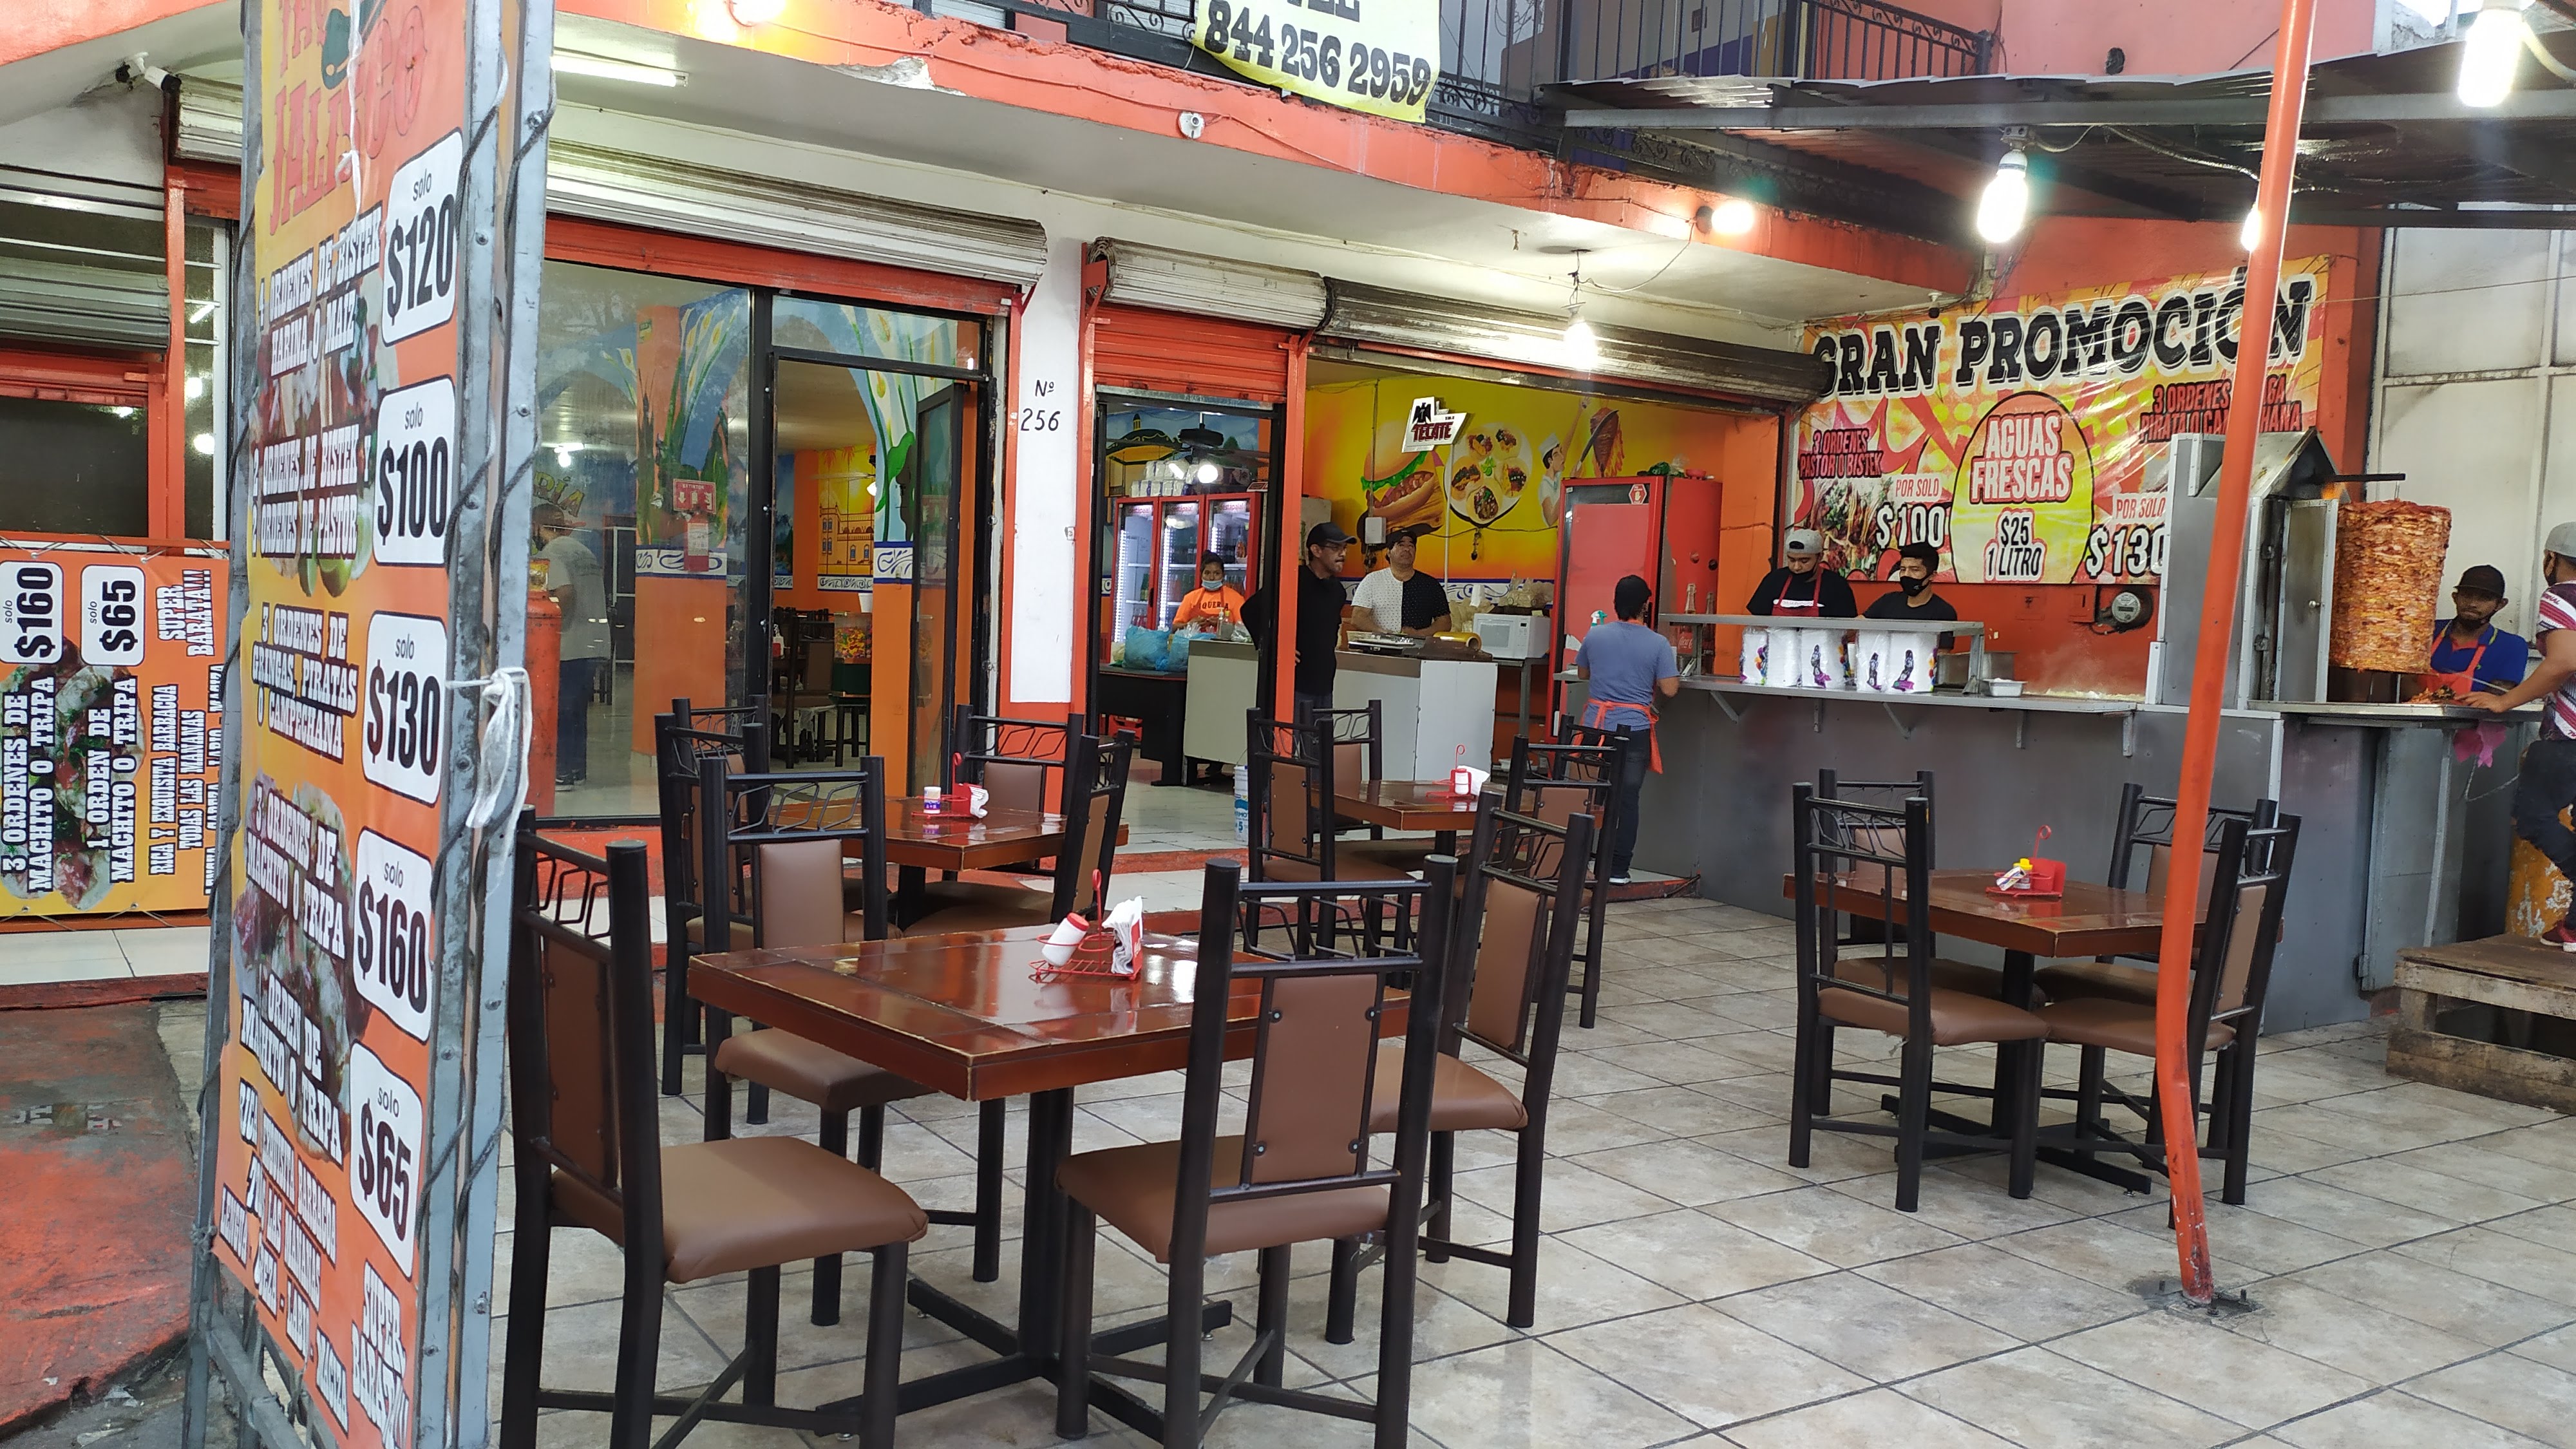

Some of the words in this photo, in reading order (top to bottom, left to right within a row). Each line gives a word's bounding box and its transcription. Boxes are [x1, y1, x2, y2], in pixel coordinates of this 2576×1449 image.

[1204, 0, 1274, 68] 844
[1281, 24, 1341, 88] 256
[1348, 42, 1431, 106] 2959
[413, 171, 432, 202] solo
[258, 279, 265, 328] 4
[270, 252, 314, 323] ORDENES
[316, 238, 334, 298] DE
[387, 194, 457, 326] $120
[271, 316, 308, 377] HARINA
[312, 307, 321, 361] O
[324, 282, 355, 355] MAÍZ
[405, 402, 423, 430] solo
[1020, 408, 1061, 431] 256
[2141, 413, 2187, 442] PIRATA
[2190, 411, 2201, 433] O
[2203, 402, 2301, 435] CAHANA
[2152, 385, 2164, 413] 3
[2166, 380, 2231, 413] ORDENES
[252, 449, 258, 497] 2
[263, 439, 301, 495] ORDENES
[303, 435, 317, 490] DE
[321, 424, 359, 488] BISTEK
[364, 435, 371, 482] Y
[1812, 431, 1822, 454] 3
[1823, 430, 1869, 454] ORDENES
[1987, 416, 2060, 459] AGUAS
[377, 437, 448, 546] $100
[1800, 454, 1836, 478] PASTOR
[1837, 453, 1845, 478] O
[1846, 452, 1882, 477] BISTEK
[1895, 479, 1914, 497] POR
[1916, 478, 1940, 497] SOLO
[1971, 457, 2072, 500] FRESCAS
[252, 503, 257, 554] 2
[261, 501, 298, 554] ORDENES
[301, 499, 314, 554] DE
[318, 495, 357, 554] PASTOR
[1876, 502, 1946, 548] $100
[2000, 515, 2030, 547] $25
[2116, 502, 2136, 520] POR
[2139, 497, 2165, 518] SOLO
[1987, 548, 1994, 576] 1
[1998, 547, 2042, 576] LITRO
[2085, 525, 2165, 578] $130
[3, 600, 13, 624] solo
[14, 567, 56, 658] $160
[88, 601, 97, 625] solo
[99, 580, 138, 652] $65
[156, 585, 187, 641] SUPER
[183, 570, 214, 656] BARATA!!!
[262, 607, 269, 643] 3
[274, 608, 322, 655] ORDENES
[328, 616, 347, 660] DE
[395, 633, 415, 660] solo
[253, 645, 296, 699] GRINGAS,
[301, 658, 358, 714] PIRATAS
[4, 695, 28, 725] DE
[30, 677, 54, 747] TRIPA
[88, 709, 111, 737] DE
[113, 678, 137, 746] TRIPA
[153, 685, 178, 752] BARBACOA
[258, 687, 264, 724] O
[269, 692, 343, 760] CAMPECHANA
[367, 659, 440, 777] $130
[30, 760, 54, 774] O
[113, 757, 135, 772] O
[176, 710, 205, 773] MAÑANAS
[3, 739, 28, 843] ORDENES
[86, 750, 110, 824] ORDEN
[151, 757, 176, 823] EXQUISITA
[180, 779, 204, 804] LAS
[28, 787, 54, 891] MACHITO
[87, 838, 110, 849] 1
[111, 783, 135, 882] MACHITO
[151, 828, 175, 838] Y
[178, 810, 204, 849] TODAS
[256, 785, 262, 831] 3
[267, 792, 311, 871] ORDENES
[316, 825, 338, 888] DE
[3, 857, 26, 871] 3
[150, 843, 175, 875] RICA
[384, 861, 404, 889] solo
[247, 831, 289, 909] MACHITO
[293, 869, 300, 921] O
[303, 878, 345, 960] TRIPA
[358, 875, 428, 1014] $160
[268, 973, 301, 1055] ORDEN
[304, 1018, 322, 1081] DE
[242, 998, 285, 1095] MAHITO
[290, 1057, 296, 1112] O
[302, 1072, 343, 1169] TRIPA
[377, 1087, 399, 1118] solo
[359, 1099, 411, 1242] $65
[267, 1188, 282, 1254] LAS
[363, 1260, 406, 1378] SUPER
